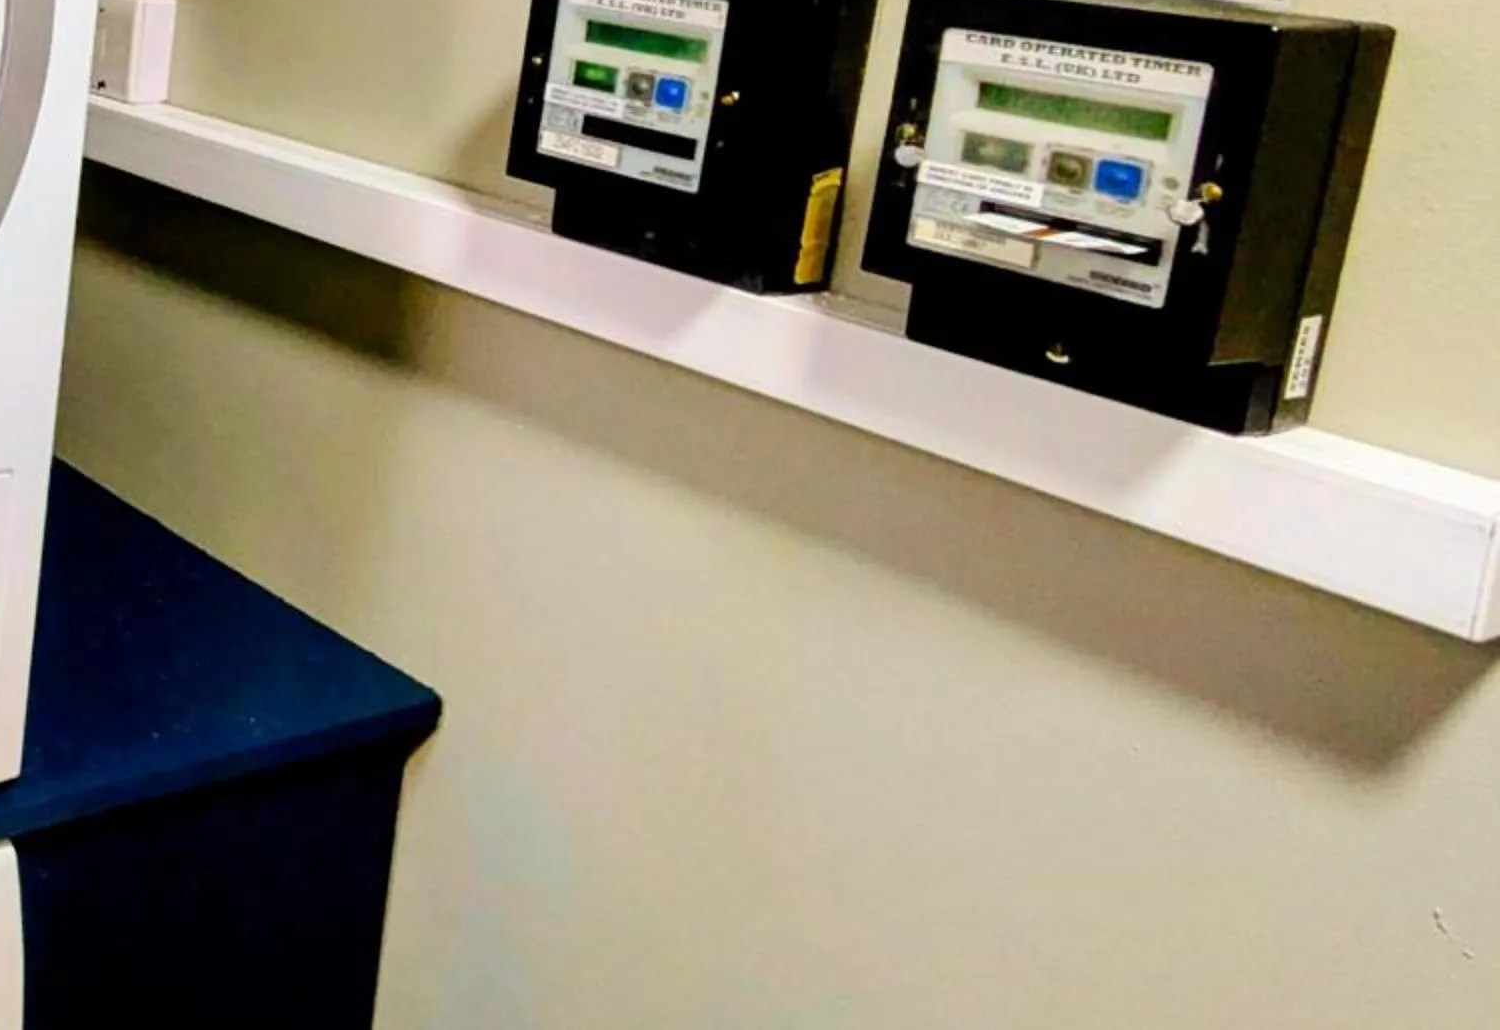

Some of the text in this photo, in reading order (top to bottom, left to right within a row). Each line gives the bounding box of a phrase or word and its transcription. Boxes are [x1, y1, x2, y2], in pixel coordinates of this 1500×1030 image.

[965, 32, 1203, 77] CARD OPERATED TIMER
[1055, 61, 1097, 78] (UK)
[1101, 69, 1142, 84] LTD
